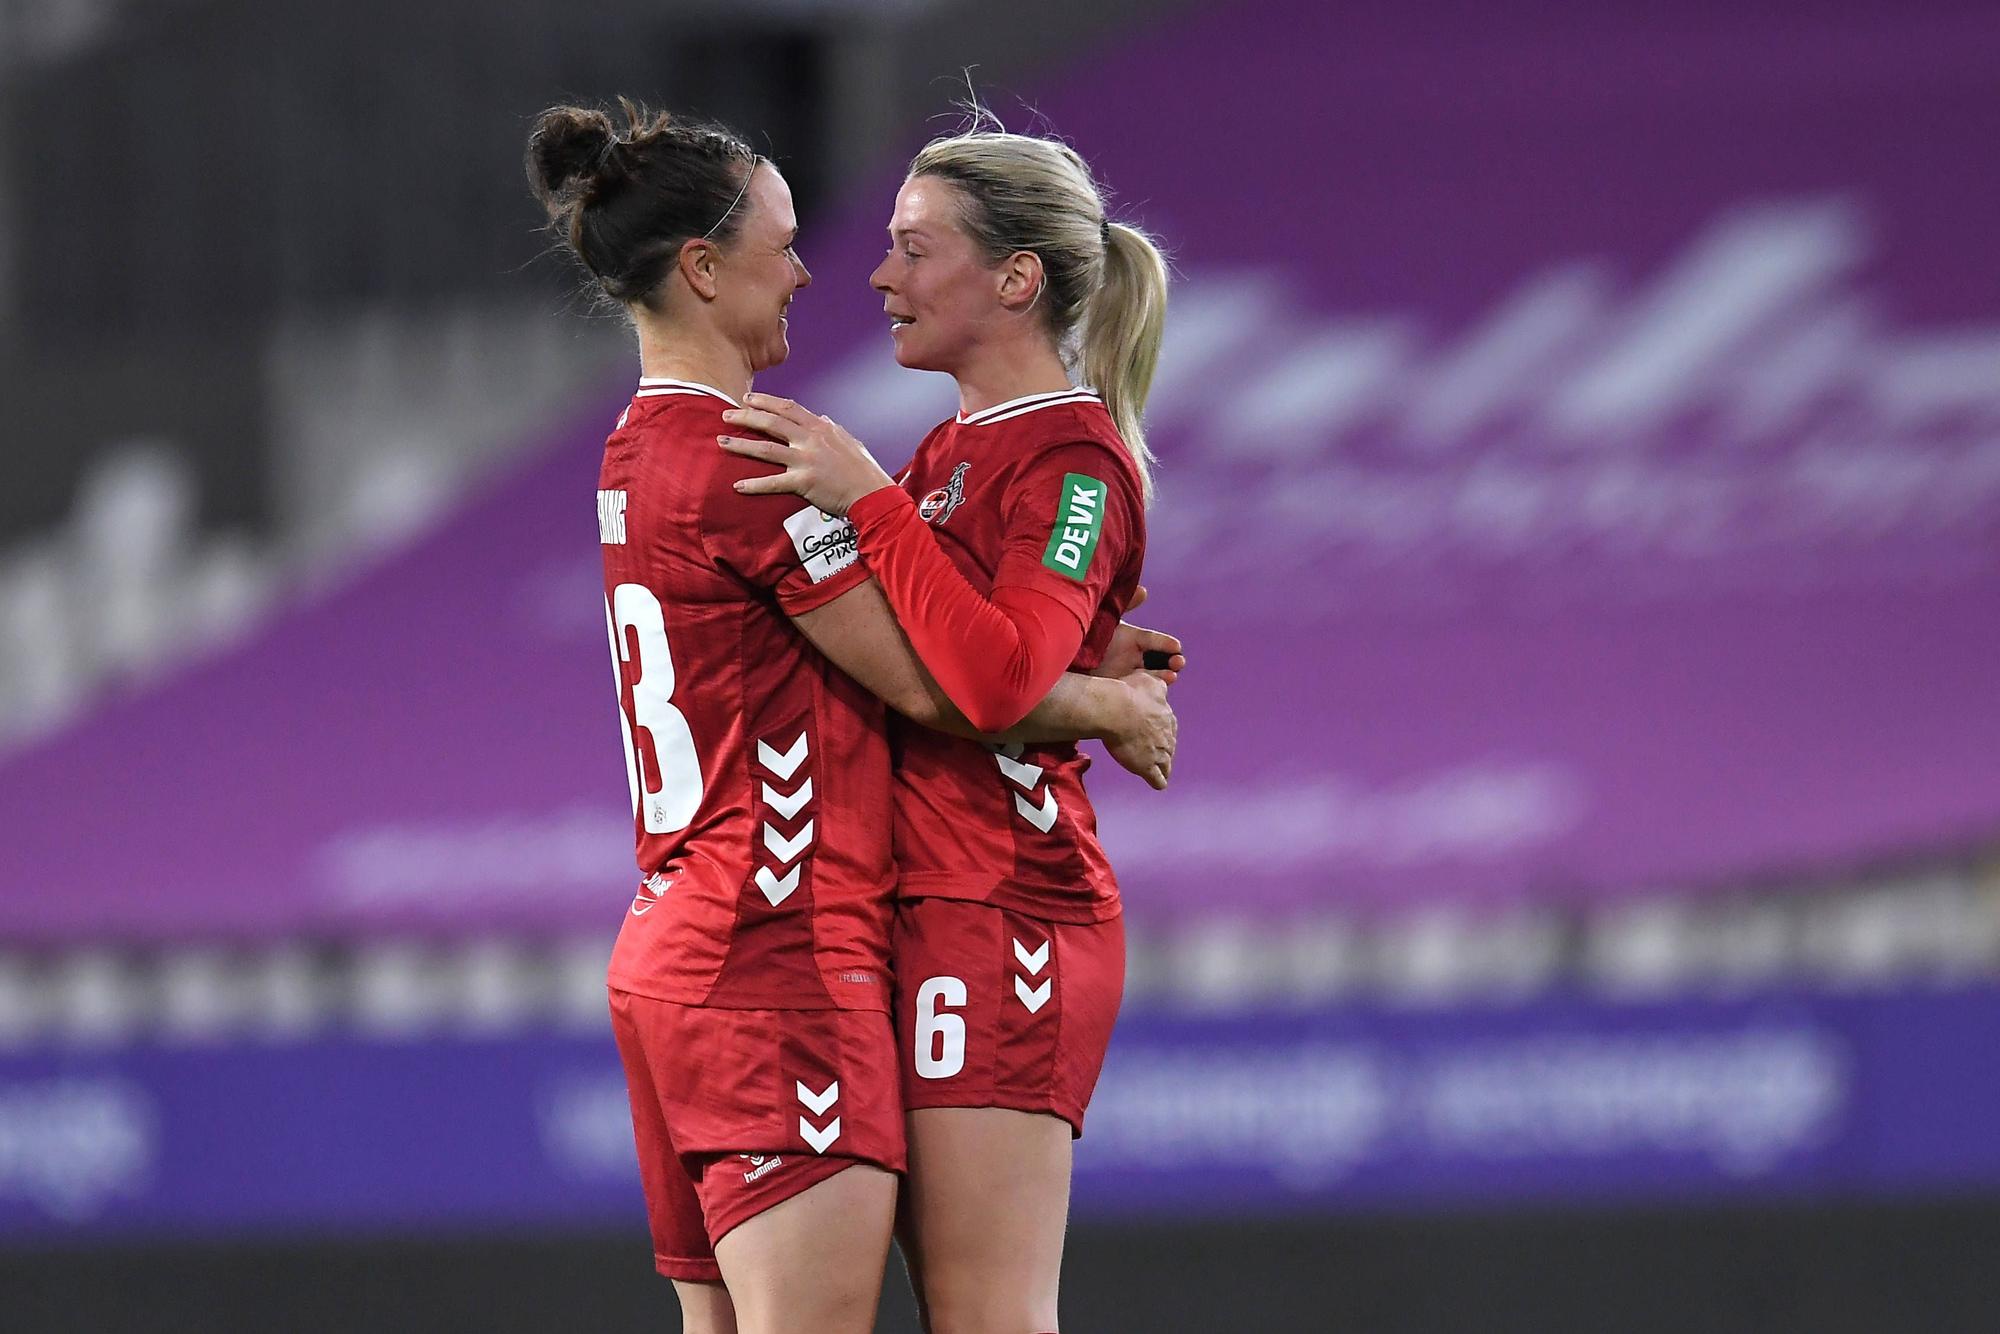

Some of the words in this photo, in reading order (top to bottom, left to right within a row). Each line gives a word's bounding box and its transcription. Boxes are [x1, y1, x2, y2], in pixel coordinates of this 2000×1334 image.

[1055, 484, 1098, 570] DEVK
[604, 583, 704, 834] 3
[915, 976, 967, 1079] 6
[744, 1155, 782, 1183] hummel
